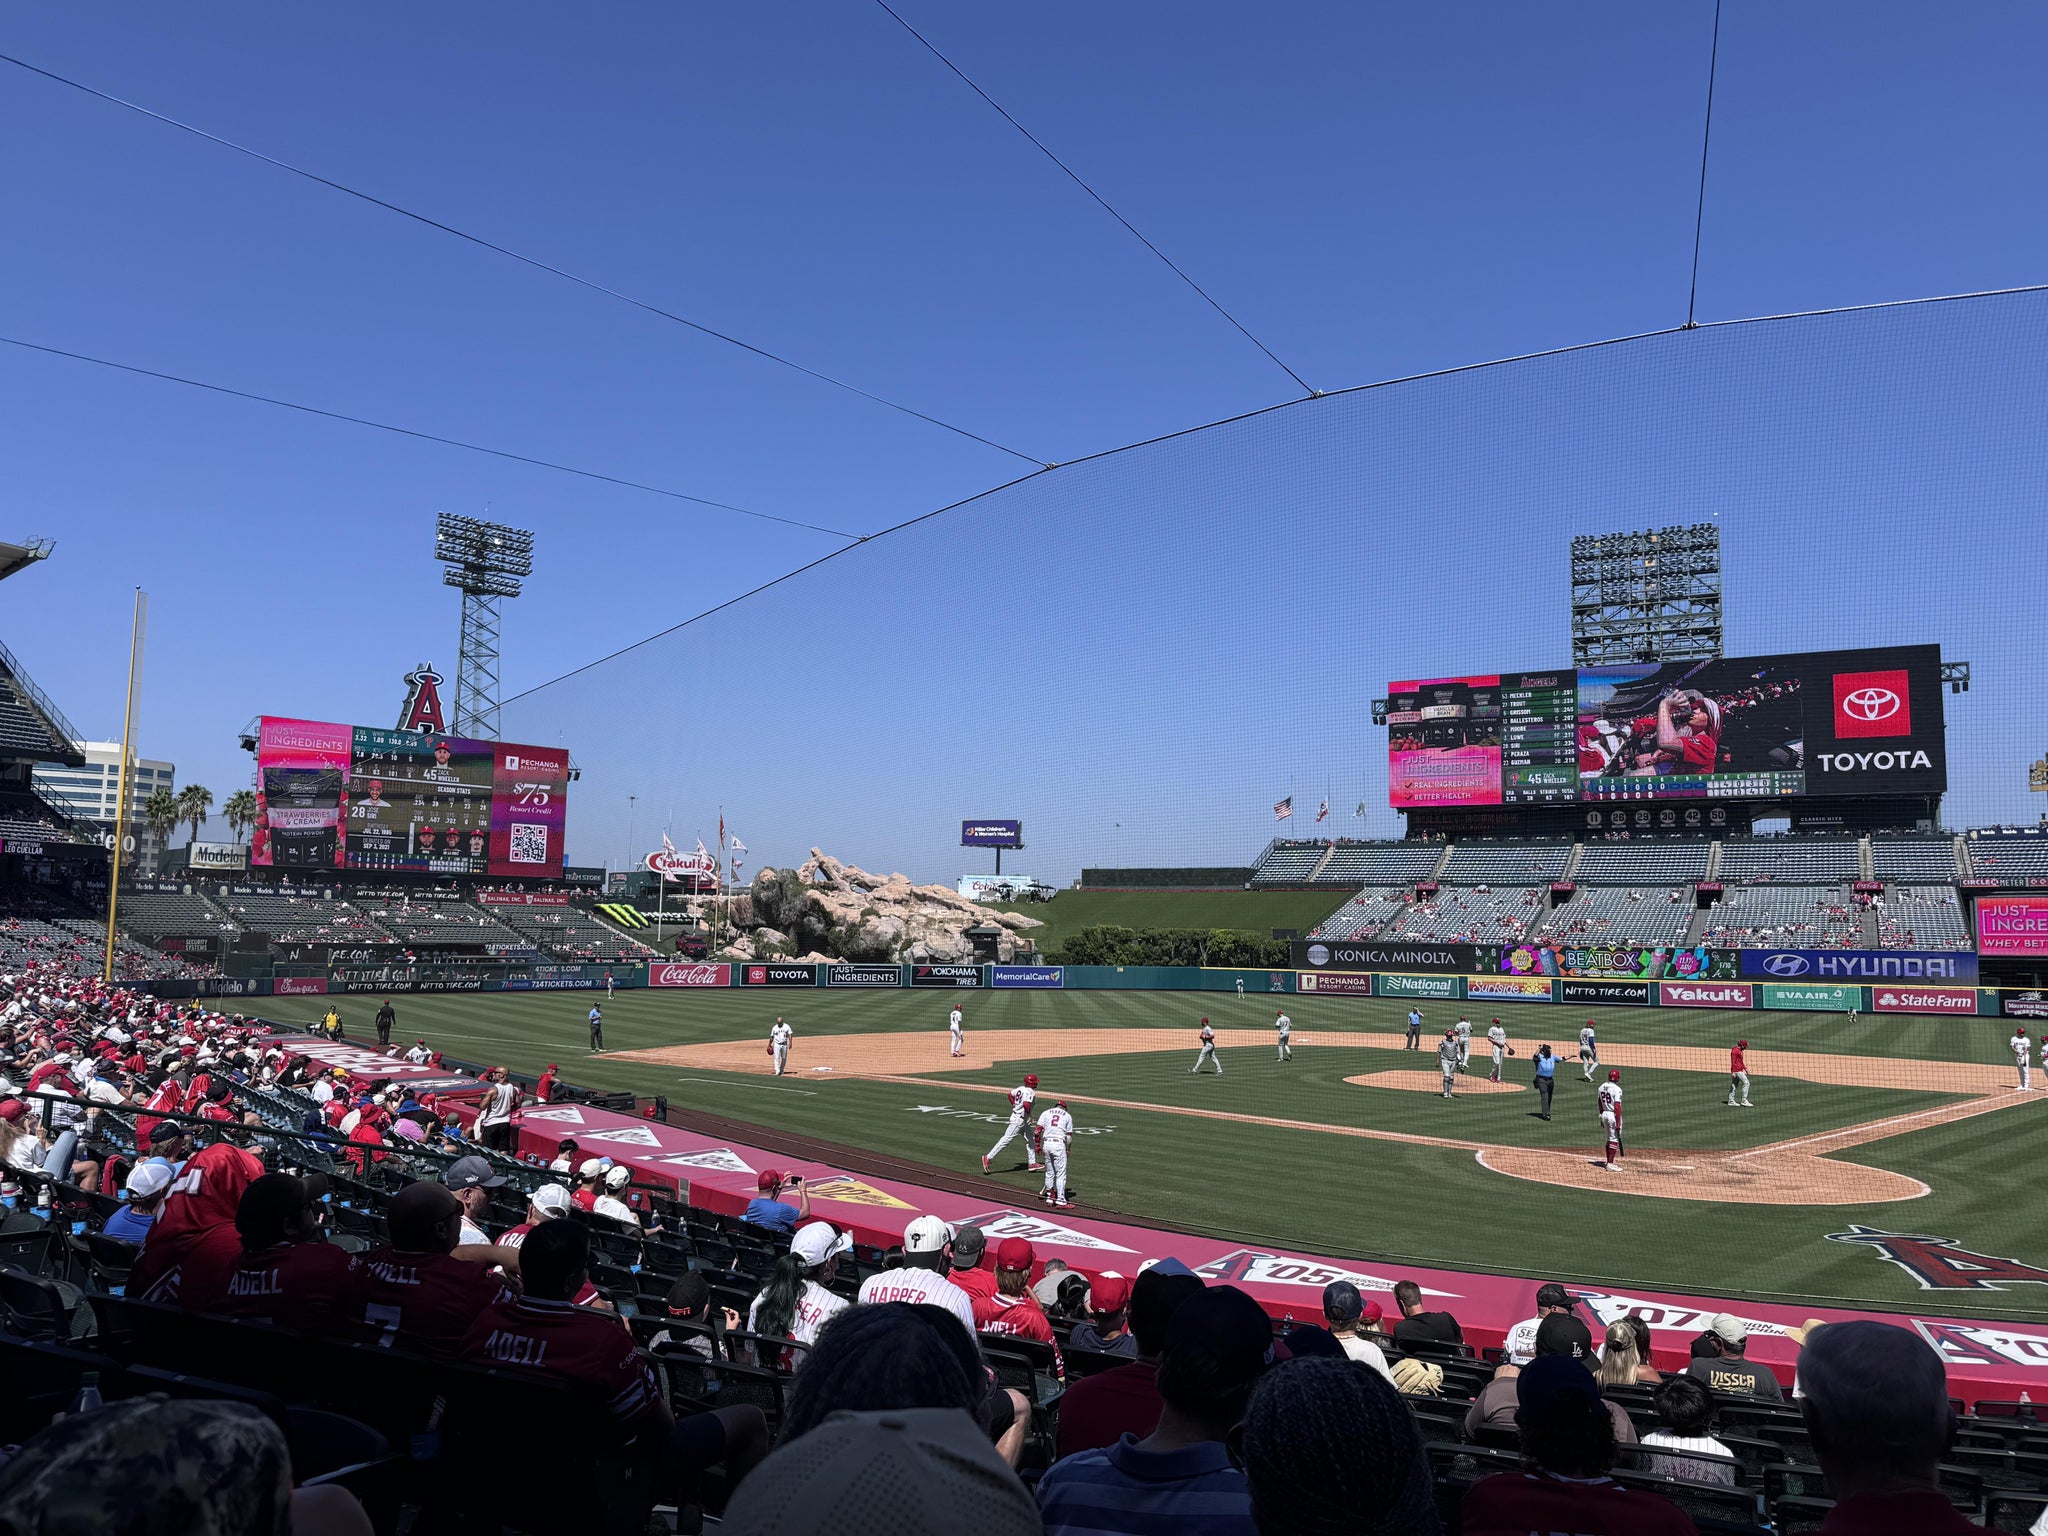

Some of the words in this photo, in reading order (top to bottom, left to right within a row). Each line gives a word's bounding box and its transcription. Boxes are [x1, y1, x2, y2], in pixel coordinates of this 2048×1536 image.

[1520, 676, 1558, 688] ANGELS
[270, 727, 295, 736] JUST
[270, 736, 343, 751] INGREDIENTS
[521, 760, 559, 768] PECHANGA
[1408, 756, 1431, 764] JUST
[1818, 750, 1932, 772] TOYOTA
[424, 769, 437, 780] 45
[1408, 764, 1482, 774] INGREDIENTS
[1528, 774, 1541, 784] 45
[514, 782, 551, 806] $75
[276, 811, 331, 819] STRAWBERRIES
[352, 806, 366, 818] 28
[1590, 812, 1598, 822] 11
[1612, 812, 1624, 822] 26
[1638, 812, 1649, 821] 29
[1662, 812, 1674, 820] 30
[1686, 811, 1698, 820] 42
[1711, 810, 1724, 820] 50
[16, 846, 43, 854] CUELLAR
[200, 846, 240, 864] Modelo
[565, 872, 582, 881] TEAM
[1990, 906, 2029, 916] JUST
[1992, 919, 2048, 931] INGRE
[1984, 939, 2020, 948] WHEY
[1334, 950, 1388, 962] KONICA
[1392, 952, 1456, 964] MINOLTA
[1568, 952, 1637, 967] BEATBOX
[931, 968, 977, 976] YOKOHAMA
[1819, 956, 1954, 978] HYUNDAI
[659, 964, 719, 984] Coca-Cola
[770, 970, 809, 979] TOYOTA
[834, 974, 894, 982] INGREDIENTS
[996, 972, 1050, 982] MemorialCare
[210, 981, 242, 992] Modelo
[532, 980, 592, 988] 714TICKETS.COM
[1402, 978, 1451, 990] National
[1472, 981, 1520, 994] Surfside
[1566, 986, 1596, 996] NITTO
[1599, 988, 1646, 997] TIRE.COM
[1666, 988, 1746, 1002] Yakult
[284, 1043, 431, 1074] ANGELS
[1051, 1115, 1060, 1126] 2
[993, 1220, 1063, 1238] '04
[1266, 1263, 1342, 1284] '05
[227, 1268, 283, 1295] ADELL
[869, 1287, 926, 1304] HARPER
[1616, 1304, 1700, 1326] '07
[484, 1329, 548, 1368] ADELL
[1572, 1341, 1582, 1358] LA
[1710, 1370, 1755, 1388] VISSLA
